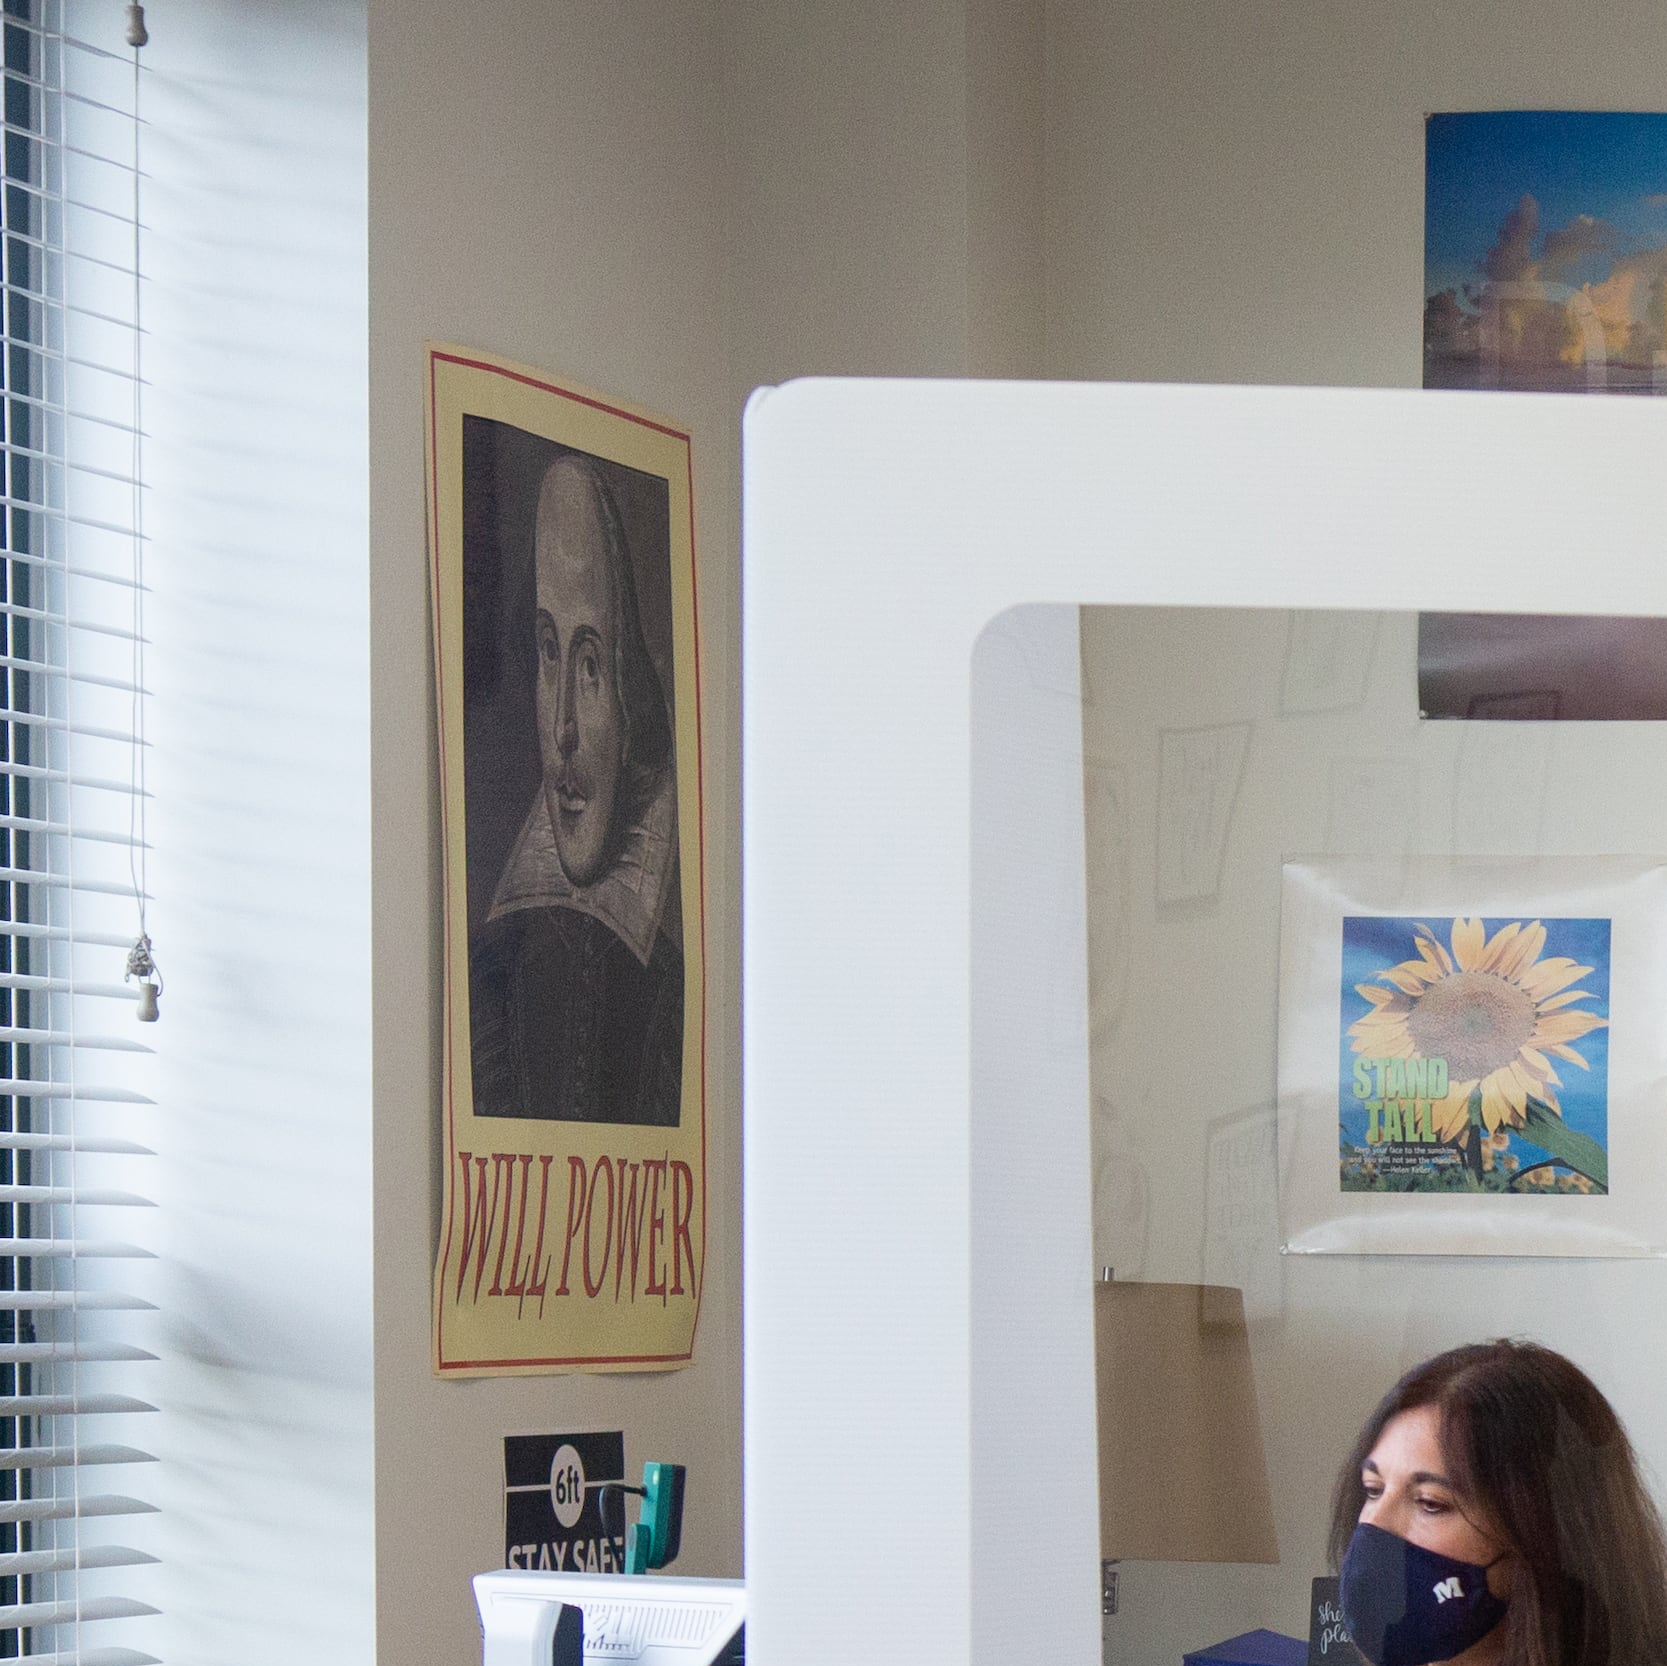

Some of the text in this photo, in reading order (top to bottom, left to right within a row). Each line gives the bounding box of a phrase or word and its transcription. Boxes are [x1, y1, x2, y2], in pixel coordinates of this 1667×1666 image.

[1352, 1056, 1449, 1099] STAND
[1364, 1101, 1437, 1143] TALL
[1389, 1146, 1403, 1154] face
[455, 1149, 698, 1320] WILL POWER
[556, 1464, 580, 1505] 6ft
[508, 1541, 568, 1571] STAY
[1432, 1576, 1465, 1604] M
